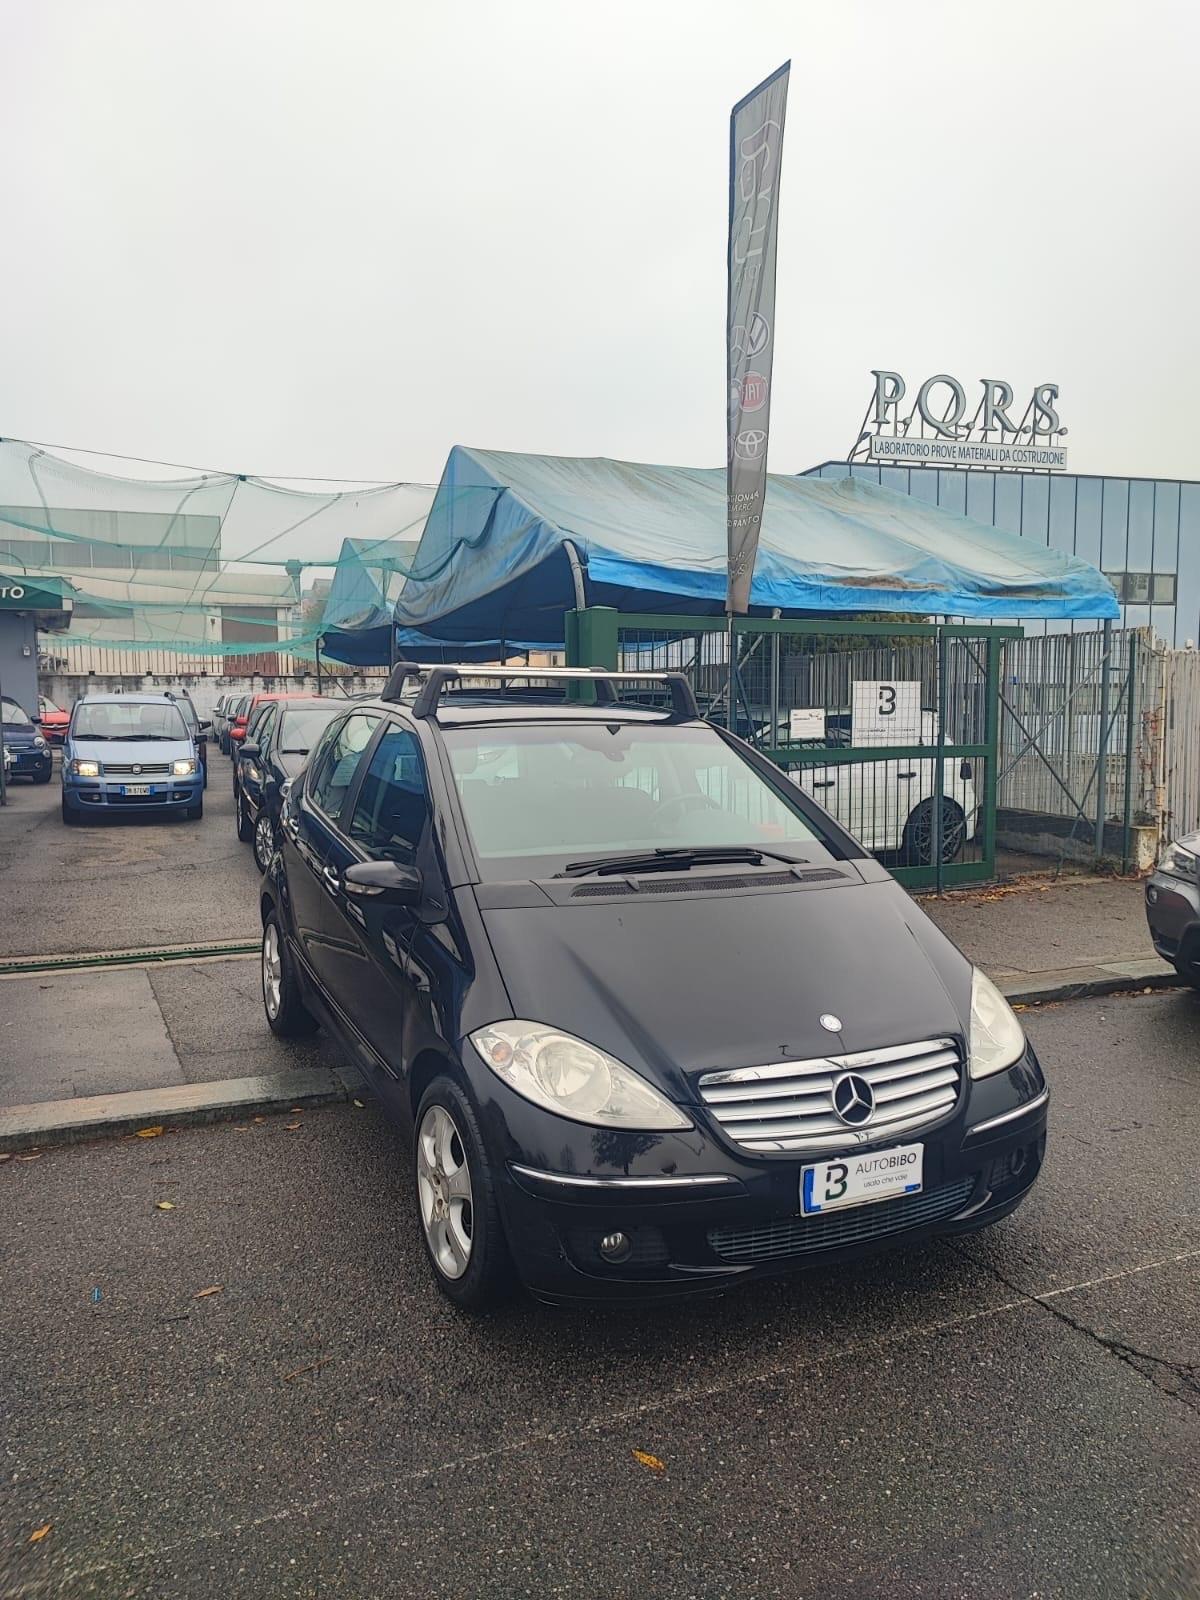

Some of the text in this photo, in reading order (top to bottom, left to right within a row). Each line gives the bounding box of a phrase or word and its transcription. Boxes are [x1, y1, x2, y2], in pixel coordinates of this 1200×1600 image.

[870, 370, 1068, 438] P.Q.R.S.
[874, 440, 1065, 465] LABORATORIO PROVE MATERIALI DA COSTRUZIONE
[856, 1152, 917, 1175] AUTOBIBO
[863, 1179, 881, 1188] usato
[881, 1176, 894, 1184] che
